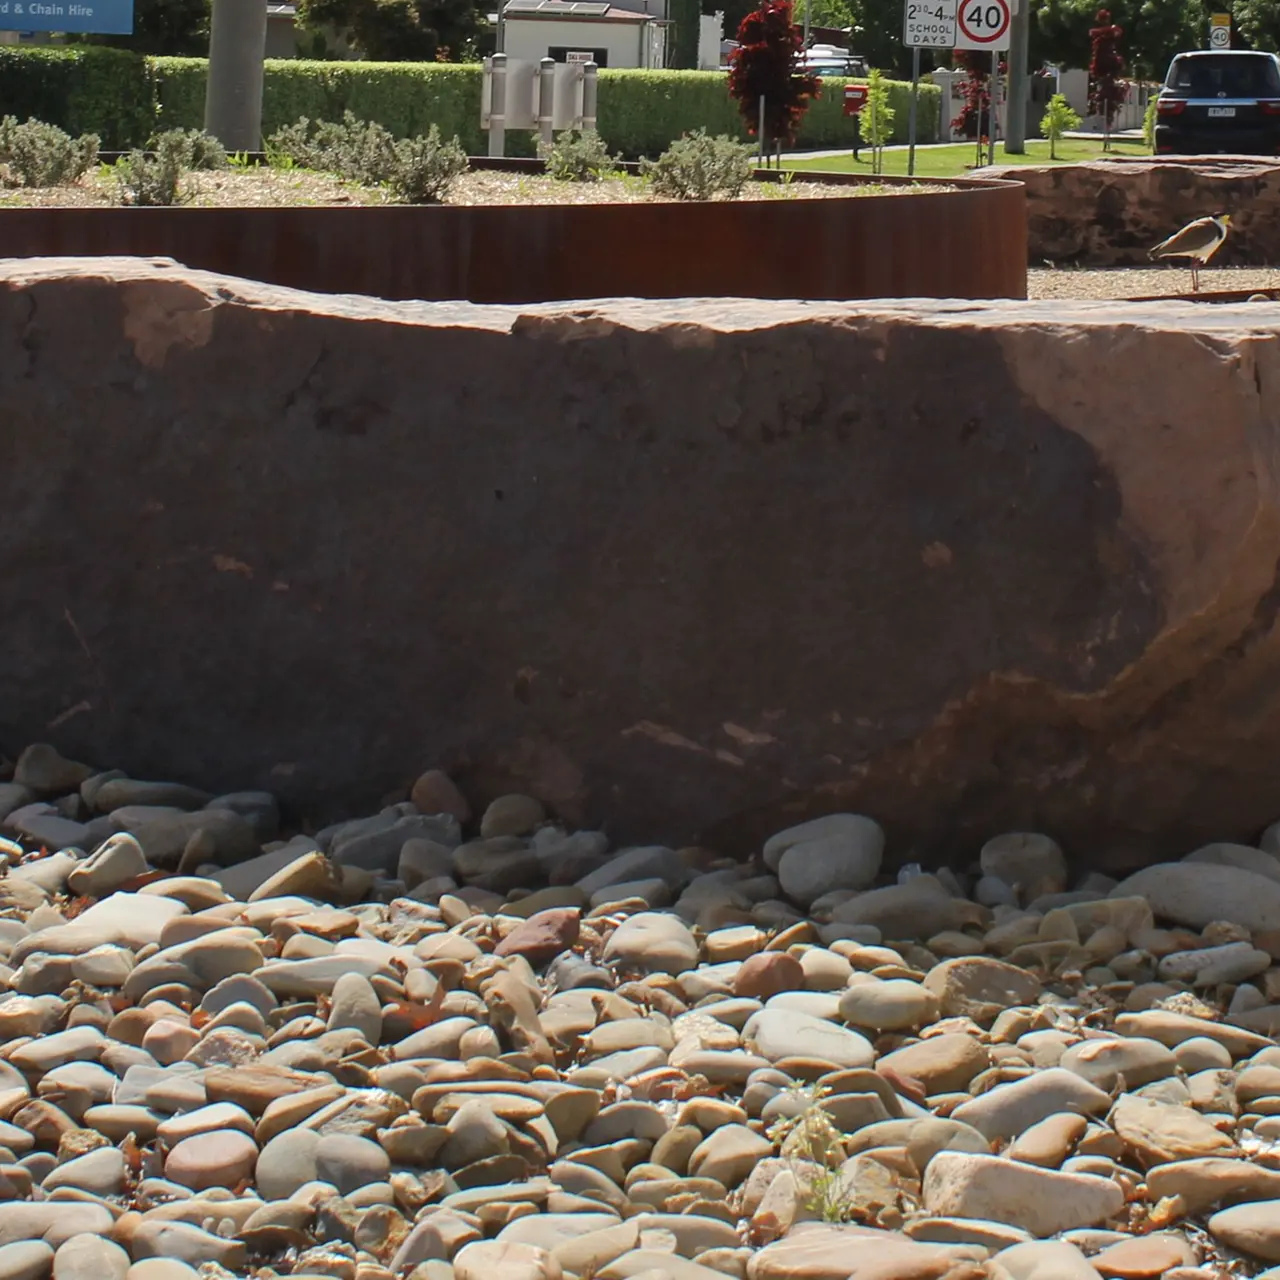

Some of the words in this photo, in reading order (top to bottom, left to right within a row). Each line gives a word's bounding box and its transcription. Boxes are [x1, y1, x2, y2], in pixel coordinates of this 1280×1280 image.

[14, 4, 23, 14] &
[29, 3, 64, 16] Chain
[69, 5, 93, 17] Hire
[966, 5, 1001, 29] 40
[909, 24, 952, 34] SCHOOL
[913, 35, 946, 44] DAYS
[1213, 32, 1227, 42] 40
